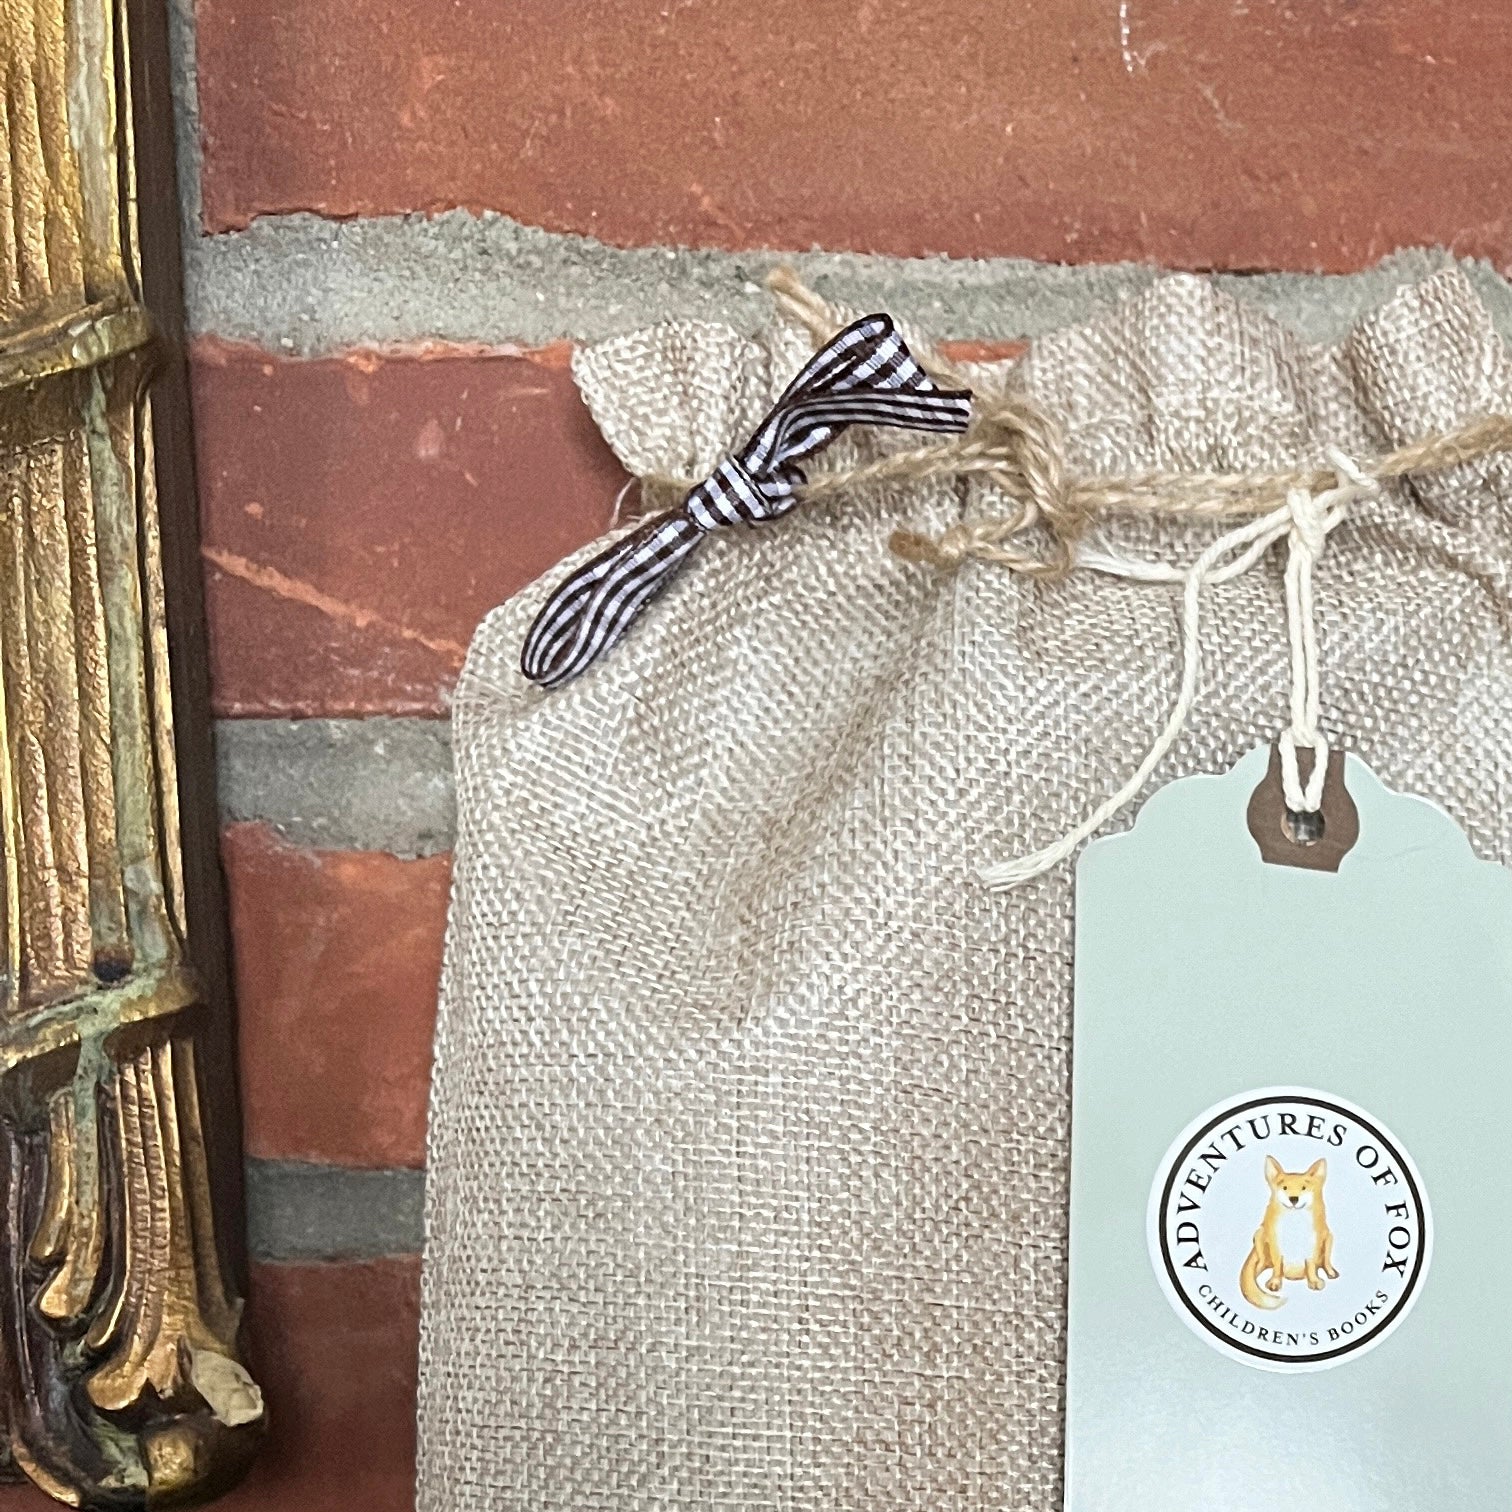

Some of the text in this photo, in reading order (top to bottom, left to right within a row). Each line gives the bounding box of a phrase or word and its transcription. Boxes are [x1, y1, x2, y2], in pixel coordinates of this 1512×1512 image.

[1176, 1112, 1411, 1278] ADVENTURES OF FOX
[1198, 1284, 1389, 1346] CHILDREN'S BOOKS
